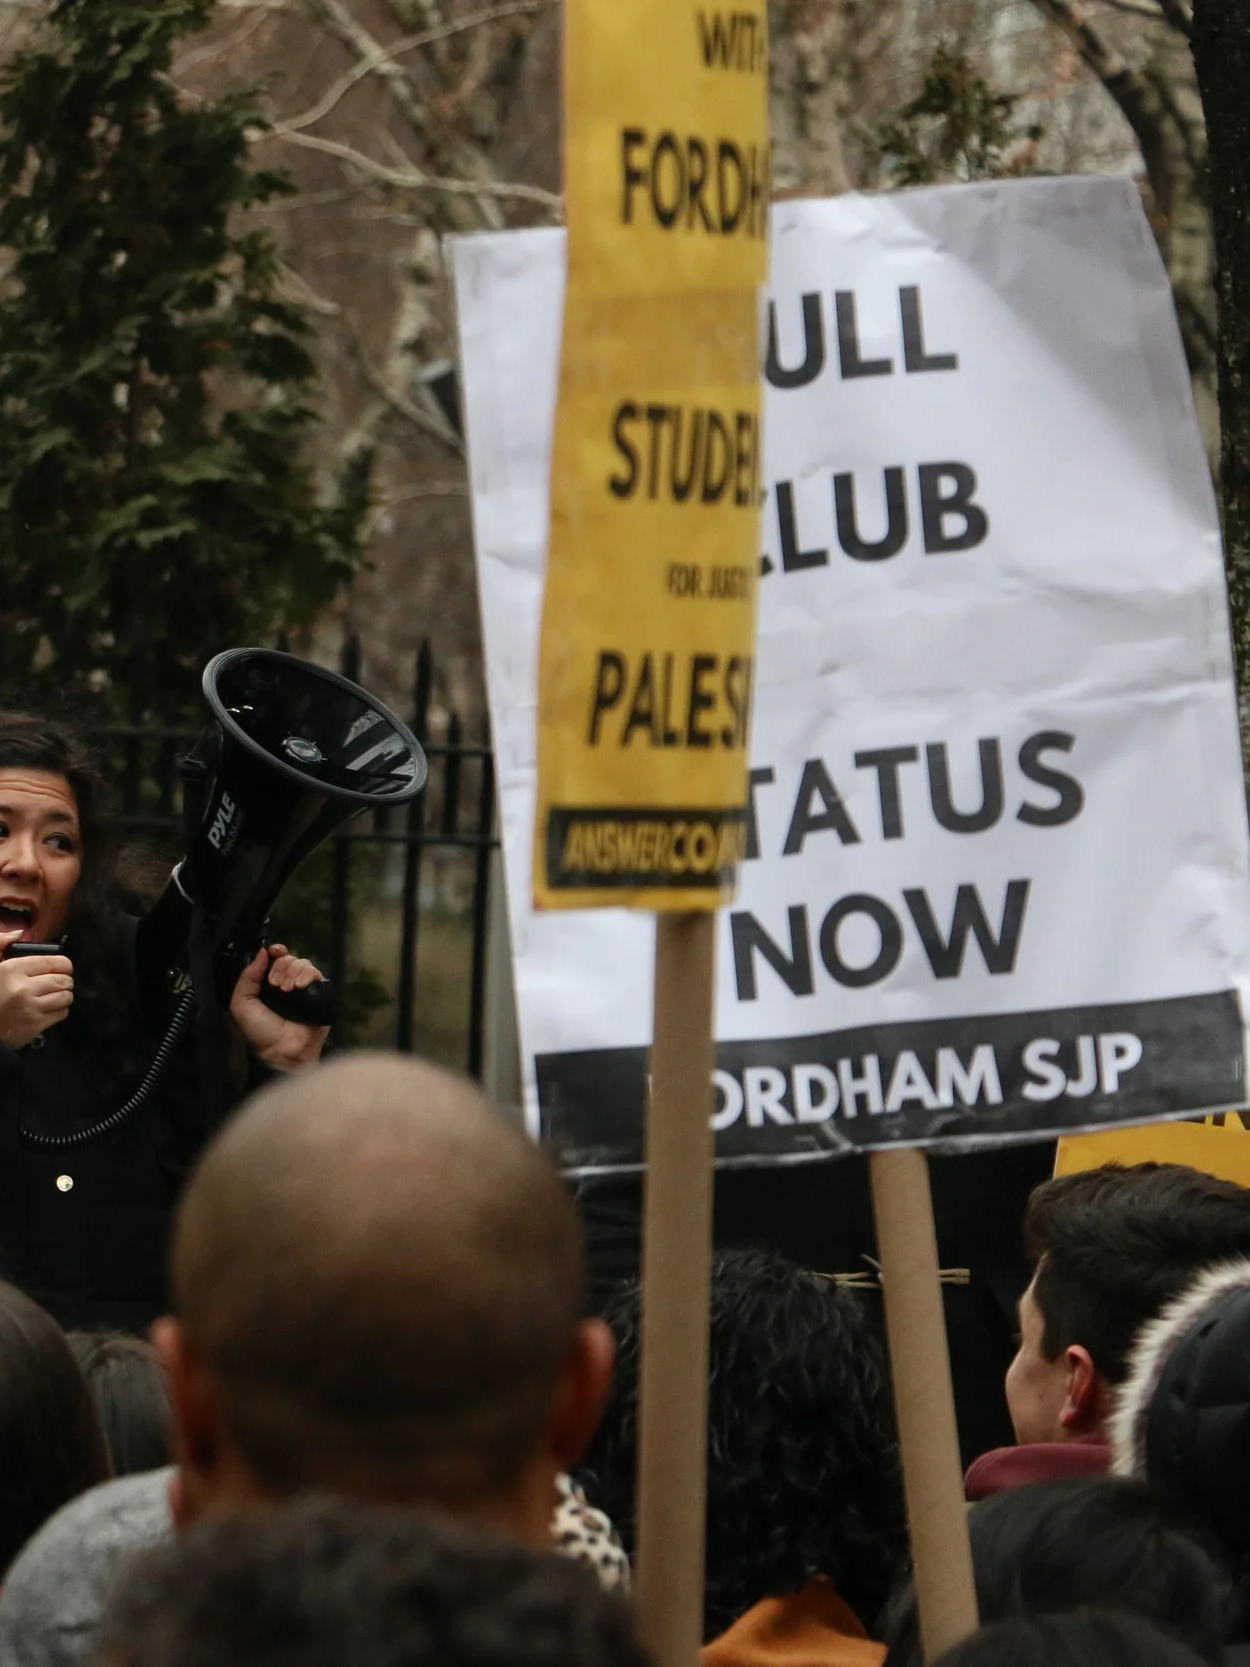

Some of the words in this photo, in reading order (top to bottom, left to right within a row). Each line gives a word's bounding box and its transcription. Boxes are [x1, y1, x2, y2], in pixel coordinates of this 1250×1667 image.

[696, 8, 763, 73] WIT
[609, 400, 759, 506] STUDE
[761, 461, 989, 575] LUB
[208, 791, 235, 849] PYLE
[729, 877, 1032, 1002] NOW
[710, 1044, 1004, 1132] ORDHAM
[1021, 1031, 1143, 1101] SJP
